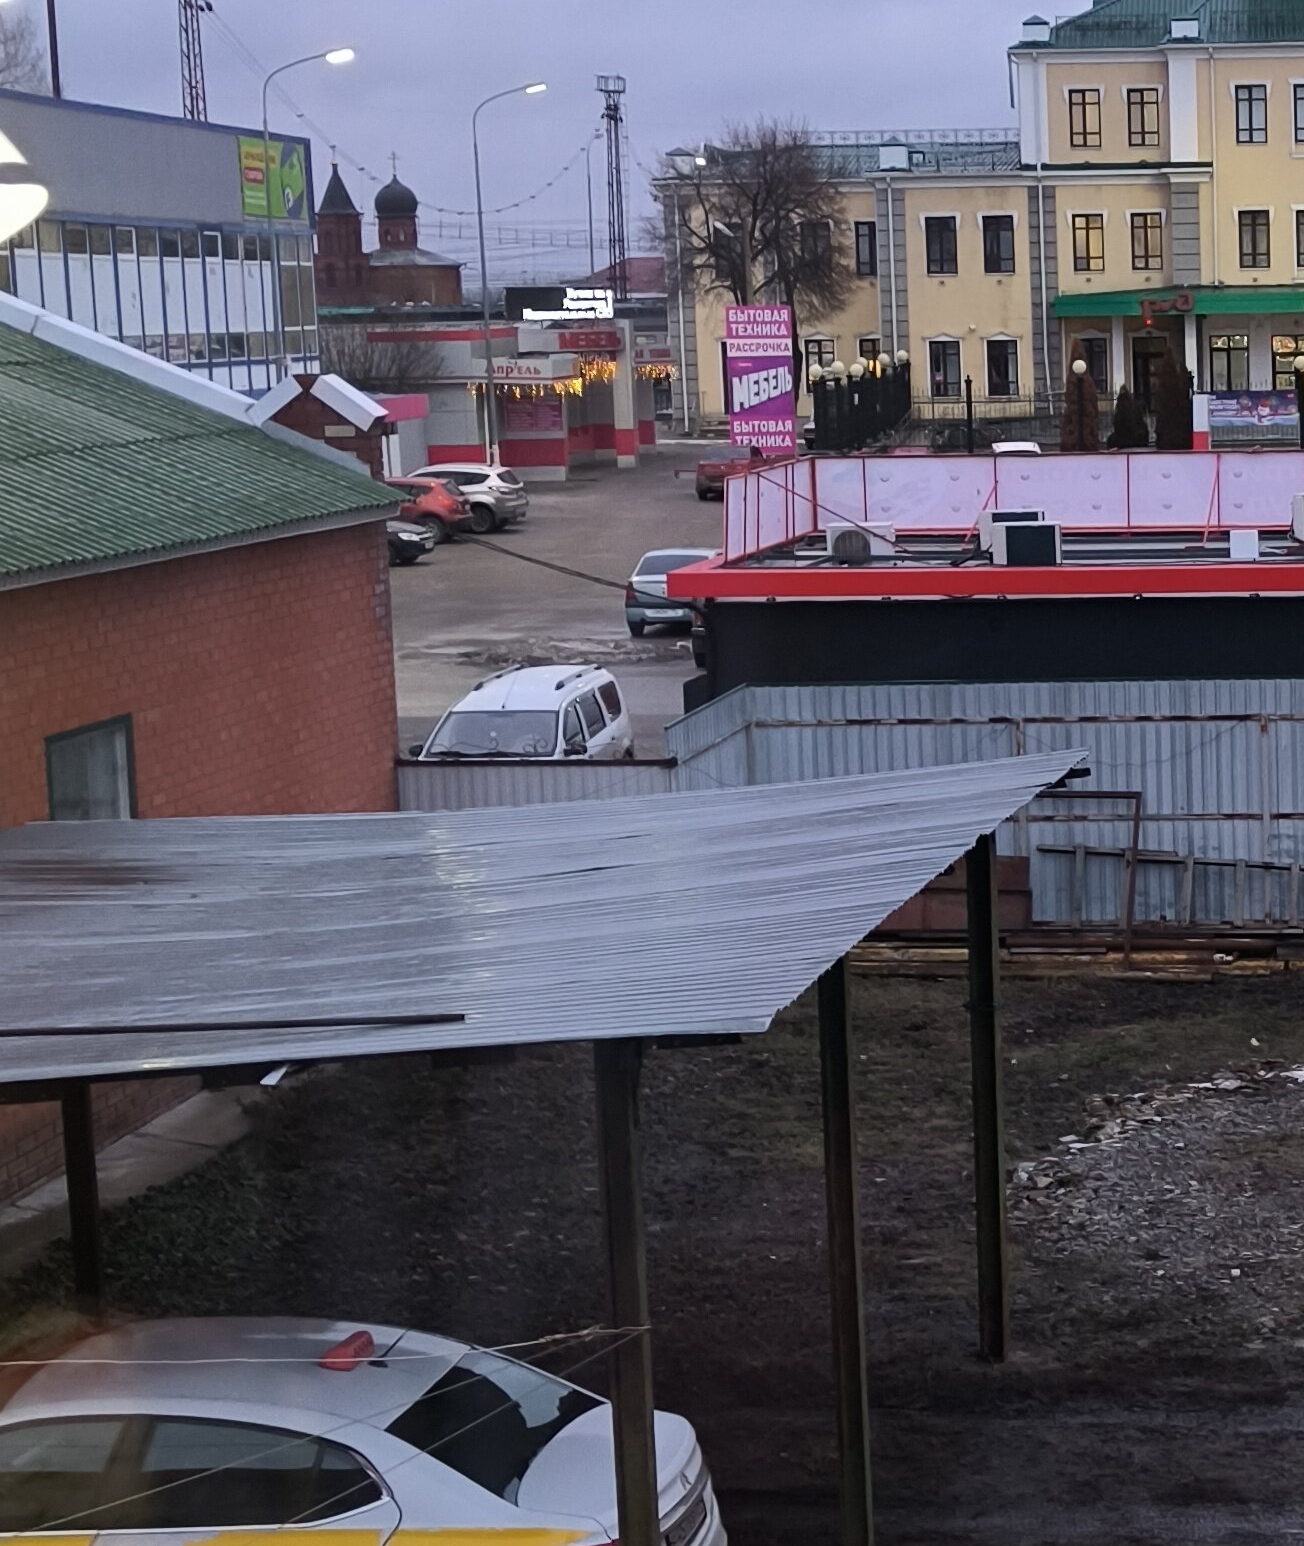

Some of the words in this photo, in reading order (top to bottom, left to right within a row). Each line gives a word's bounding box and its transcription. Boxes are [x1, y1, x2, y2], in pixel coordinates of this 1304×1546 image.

[728, 309, 788, 322] БЫТОВАЯ
[730, 323, 788, 336] ТЕХНИКА
[729, 341, 790, 353] РАССРОЧКА
[731, 365, 793, 413] МЕБЕЛЬ
[733, 419, 793, 433] БЫТОВАЯ
[735, 434, 793, 447] ТЕХНИКА
